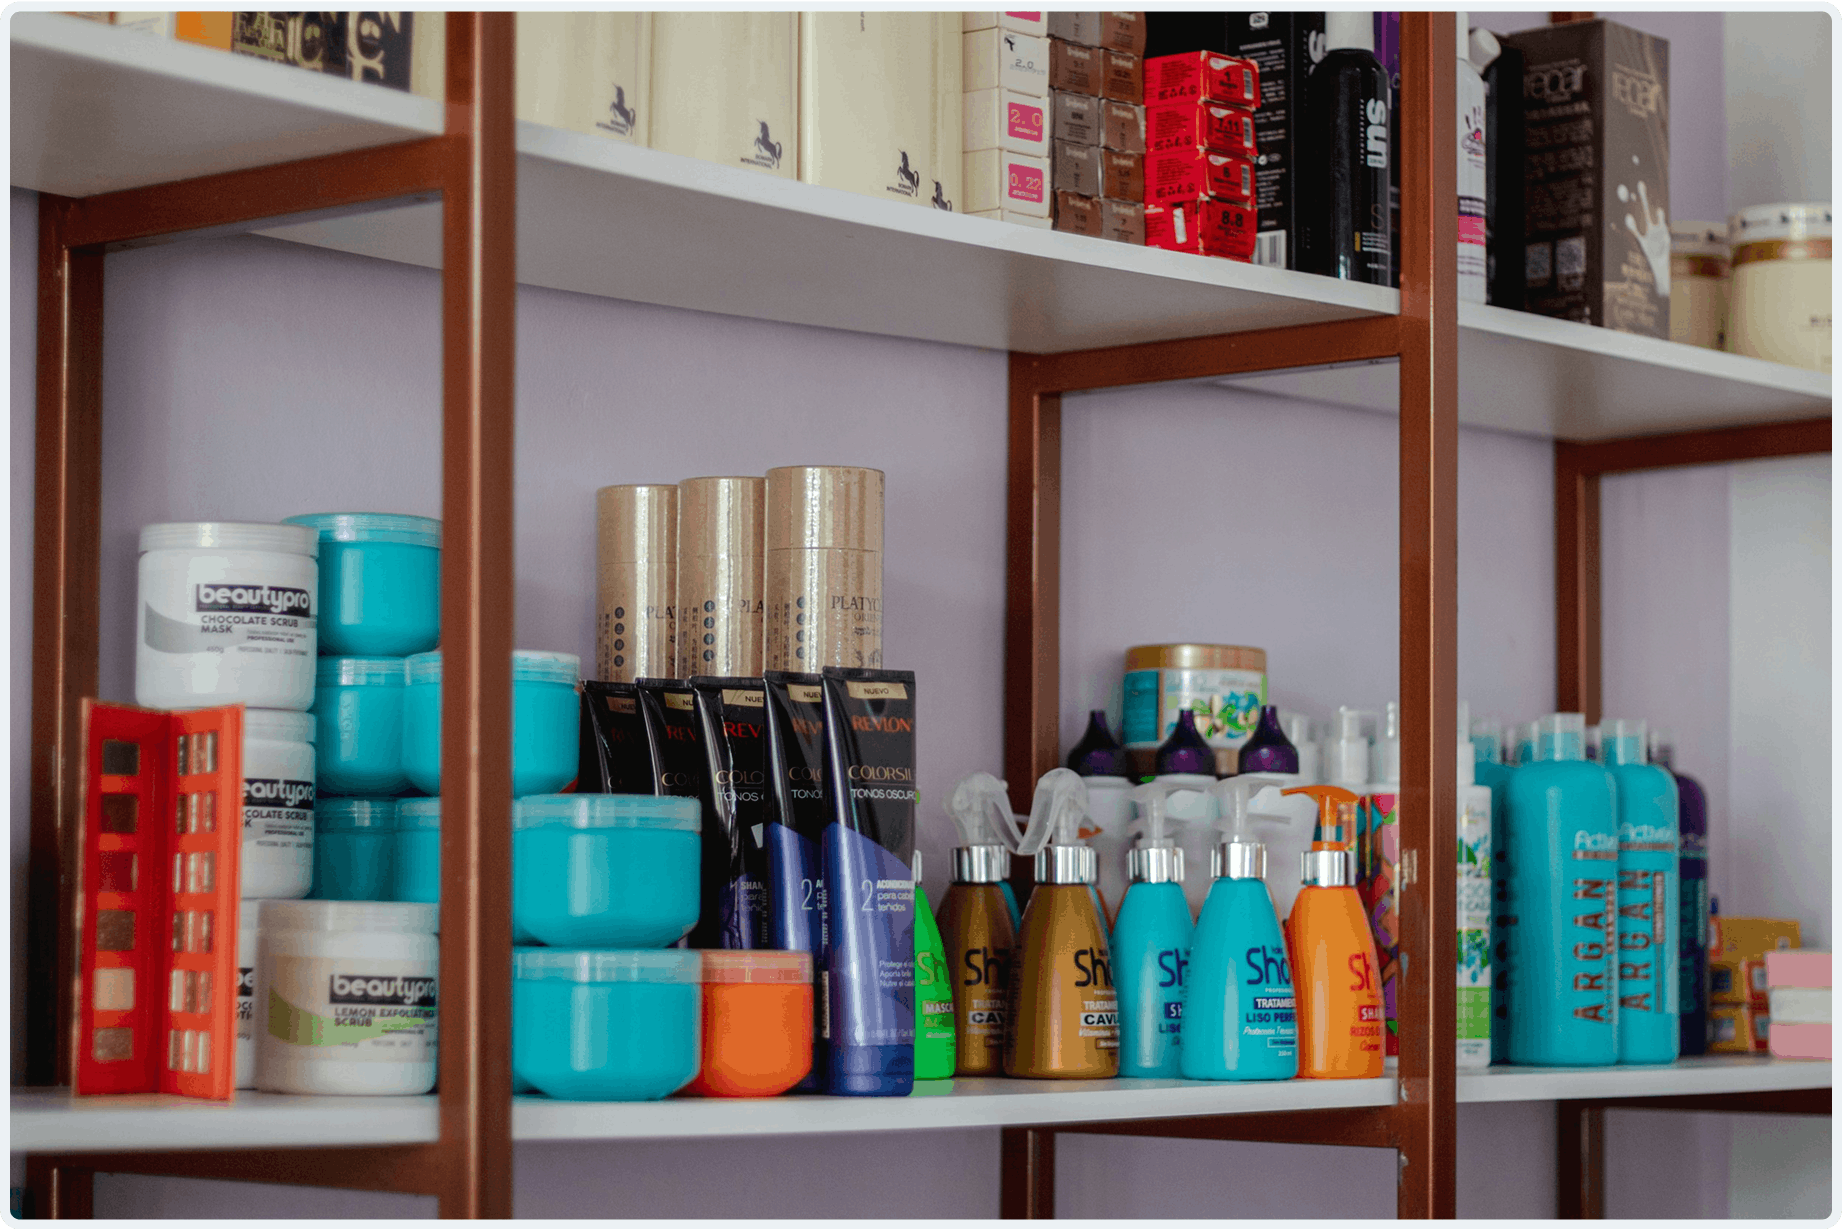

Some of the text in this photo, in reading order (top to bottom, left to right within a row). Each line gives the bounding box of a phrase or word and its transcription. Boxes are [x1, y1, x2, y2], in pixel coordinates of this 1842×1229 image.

[1366, 97, 1387, 168] sun
[1221, 210, 1243, 227] 8.8
[199, 583, 309, 613] beautypro
[201, 615, 299, 628] CHOCOLATE SCRUB
[201, 625, 233, 634] MASK
[851, 715, 911, 732] REVLON
[850, 788, 885, 799] TONOS
[801, 879, 812, 910] 2
[861, 879, 874, 911] 2
[1619, 870, 1651, 1012] ARGAN
[1573, 879, 1604, 1022] ARGAN
[335, 1007, 376, 1017] LEMON
[1246, 1012, 1271, 1023] LISO
[335, 1017, 372, 1028] SCRUB
